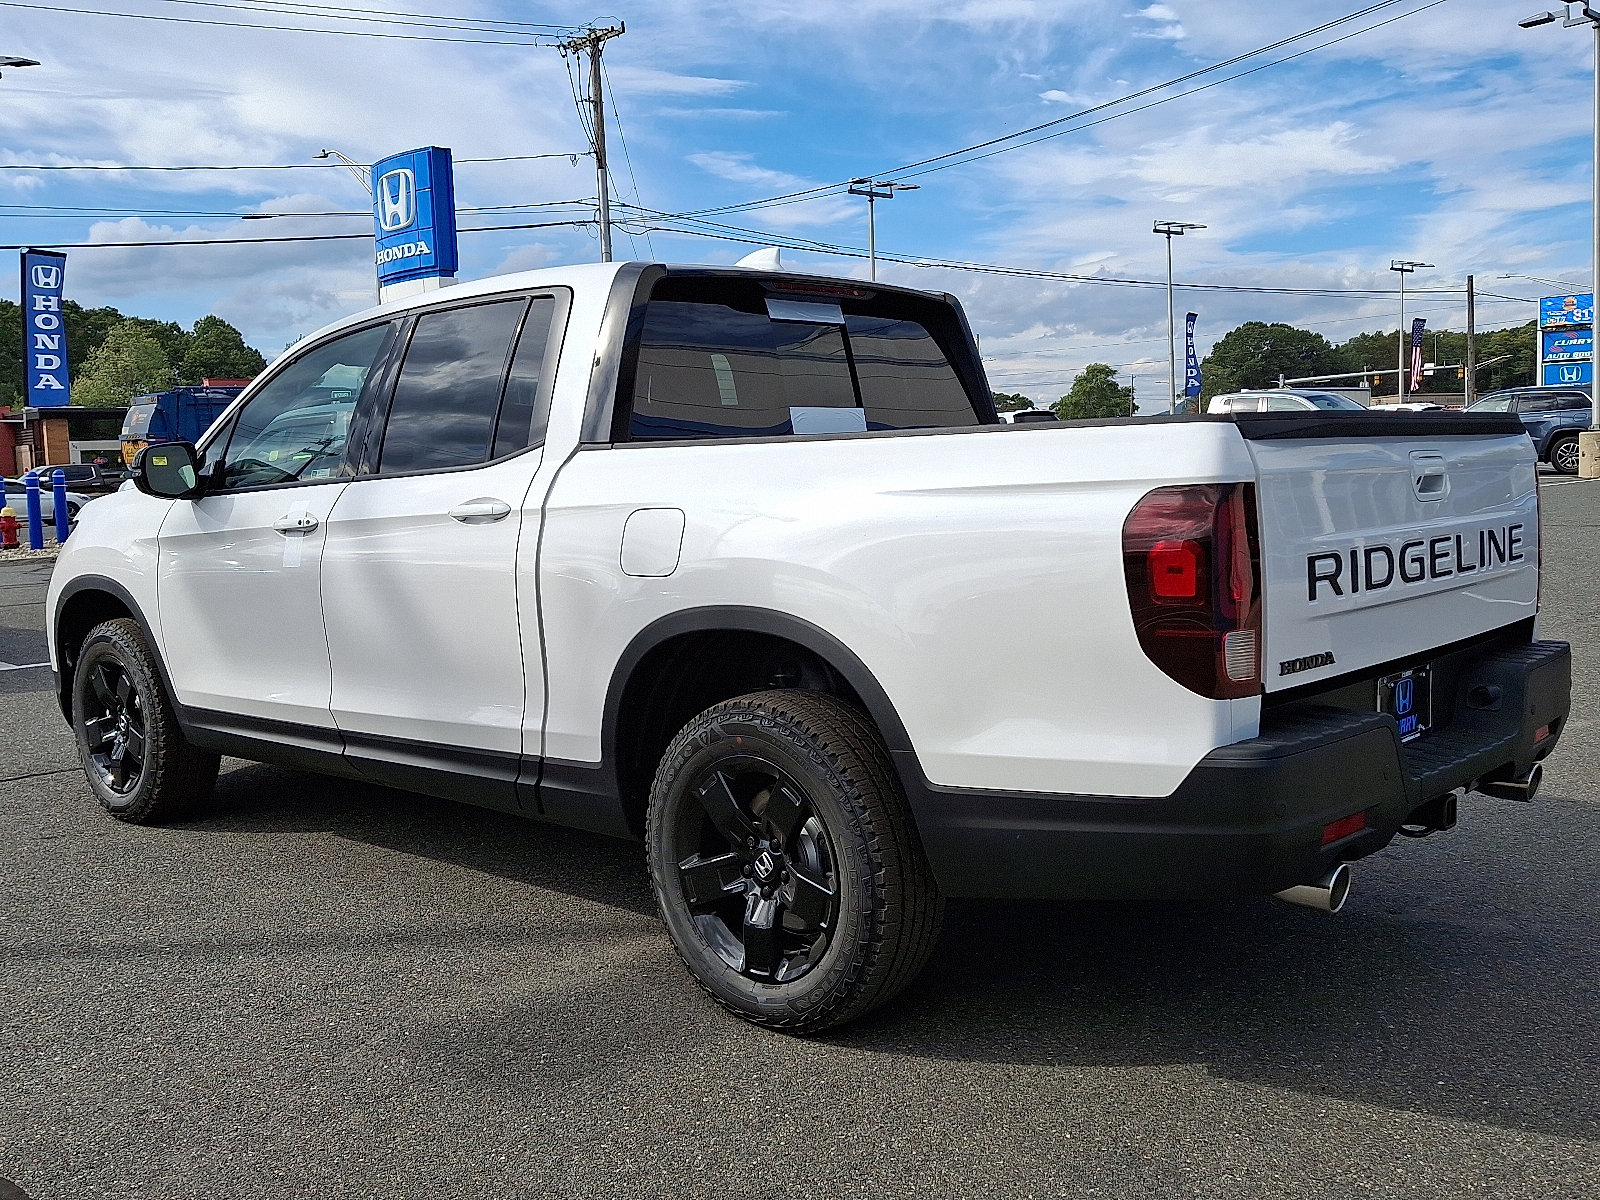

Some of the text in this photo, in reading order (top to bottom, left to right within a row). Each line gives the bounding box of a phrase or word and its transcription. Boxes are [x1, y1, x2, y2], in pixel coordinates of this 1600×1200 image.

[376, 240, 430, 265] HONDA
[33, 295, 64, 389] HONDA
[1554, 338, 1593, 346] CURRY
[1187, 337, 1200, 388] HONDA
[1306, 523, 1524, 602] RIDGELINE
[1279, 651, 1336, 676] HONDA
